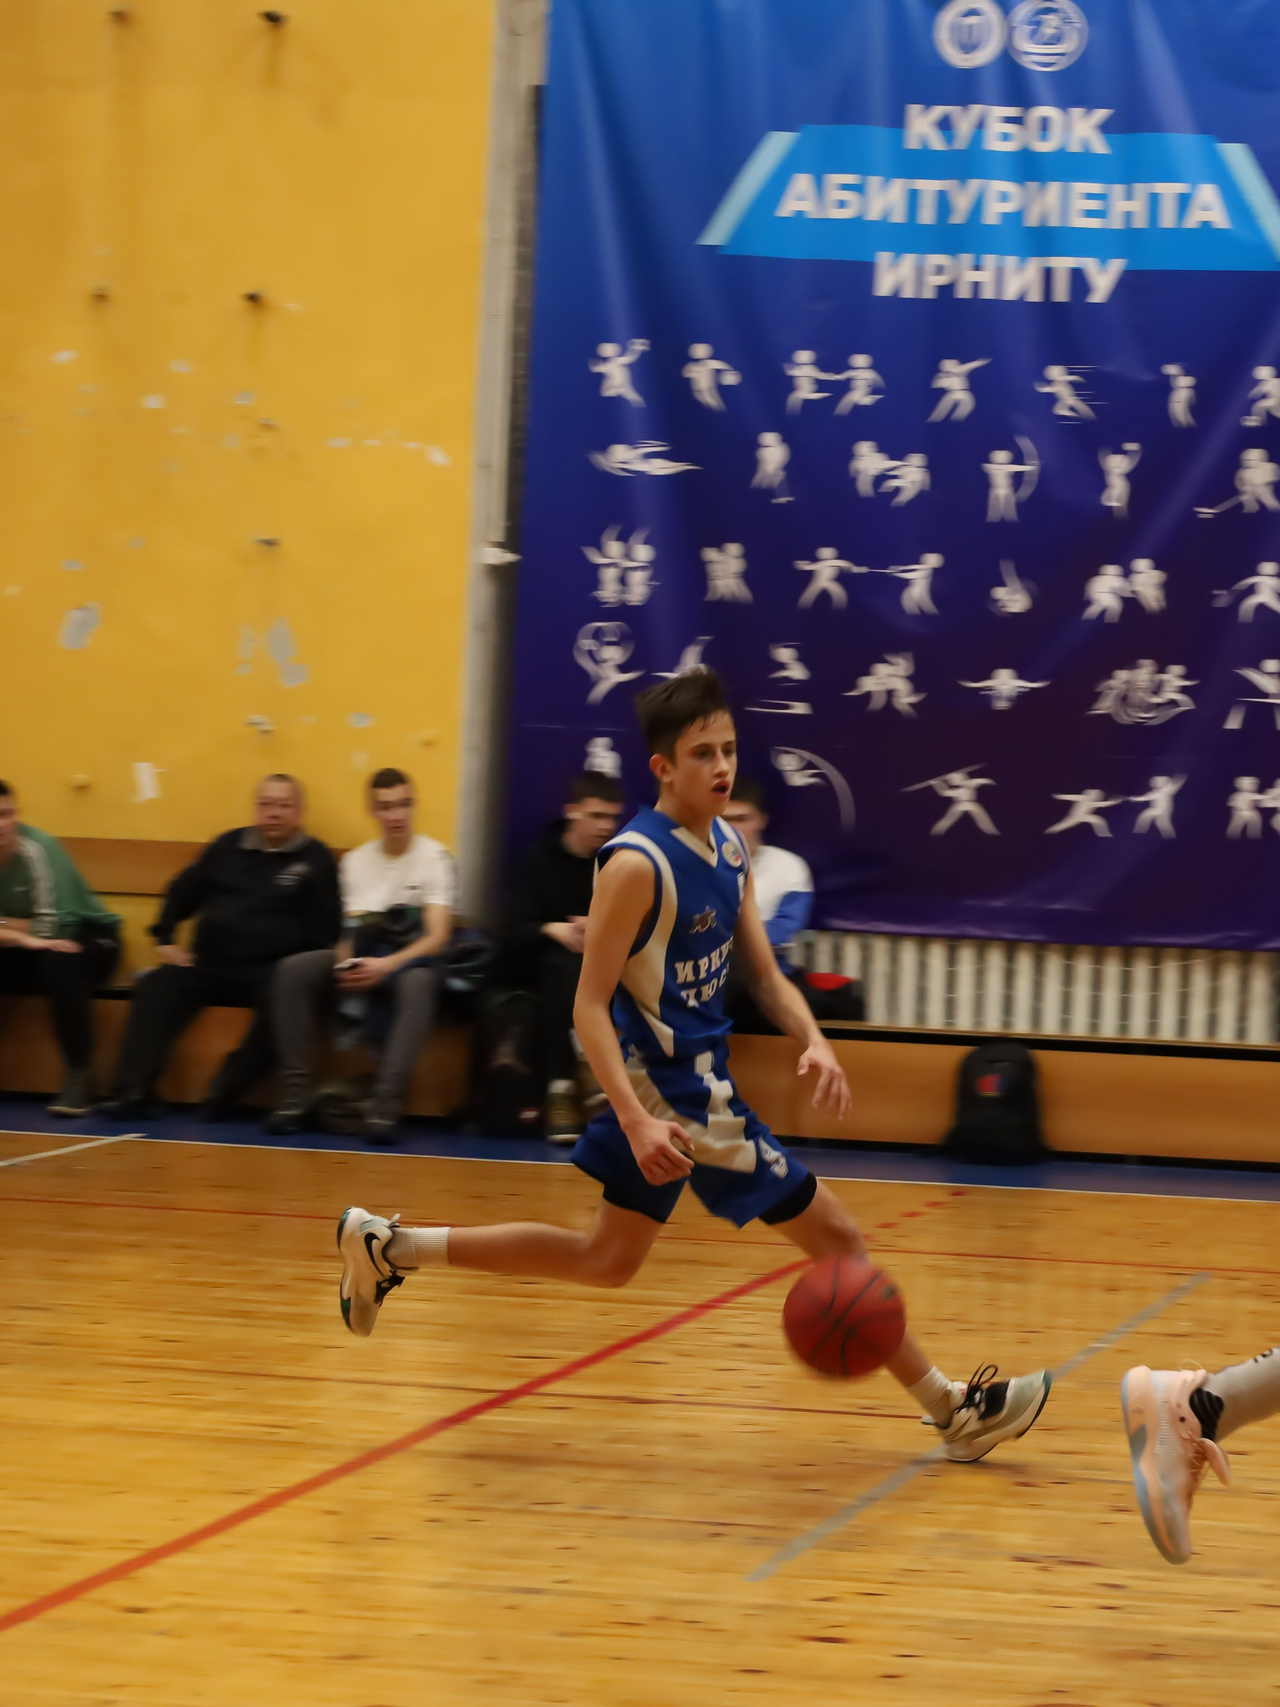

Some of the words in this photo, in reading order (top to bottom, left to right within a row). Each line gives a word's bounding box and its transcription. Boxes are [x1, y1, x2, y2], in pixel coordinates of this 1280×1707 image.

[905, 103, 1115, 154] КУБОК
[774, 173, 1233, 230] АБИТУРИЕНТА
[872, 251, 1128, 303] ИРНИТУ
